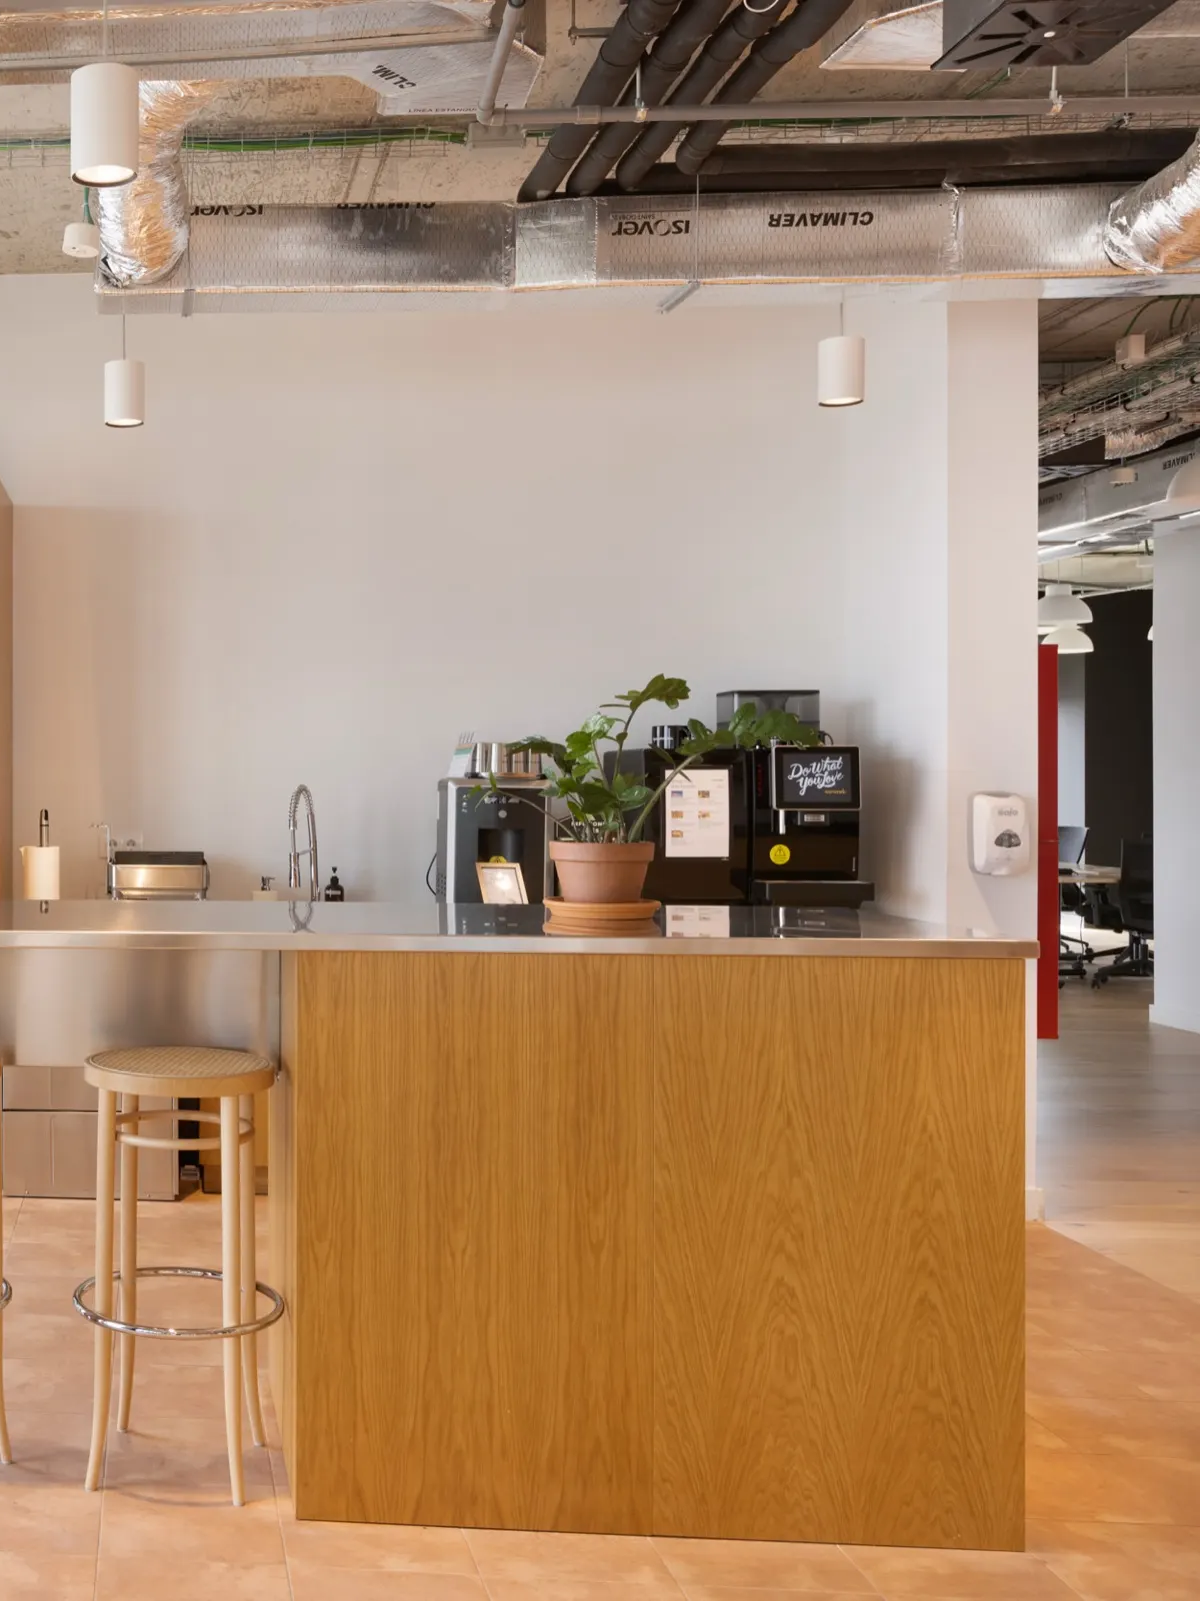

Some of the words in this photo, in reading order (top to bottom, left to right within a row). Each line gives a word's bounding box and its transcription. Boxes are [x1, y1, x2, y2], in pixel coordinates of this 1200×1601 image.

[372, 64, 417, 89] CLIM
[768, 211, 874, 228] CLIMAVER
[788, 763, 811, 780] Do
[811, 756, 843, 773] What
[816, 770, 845, 789] Love
